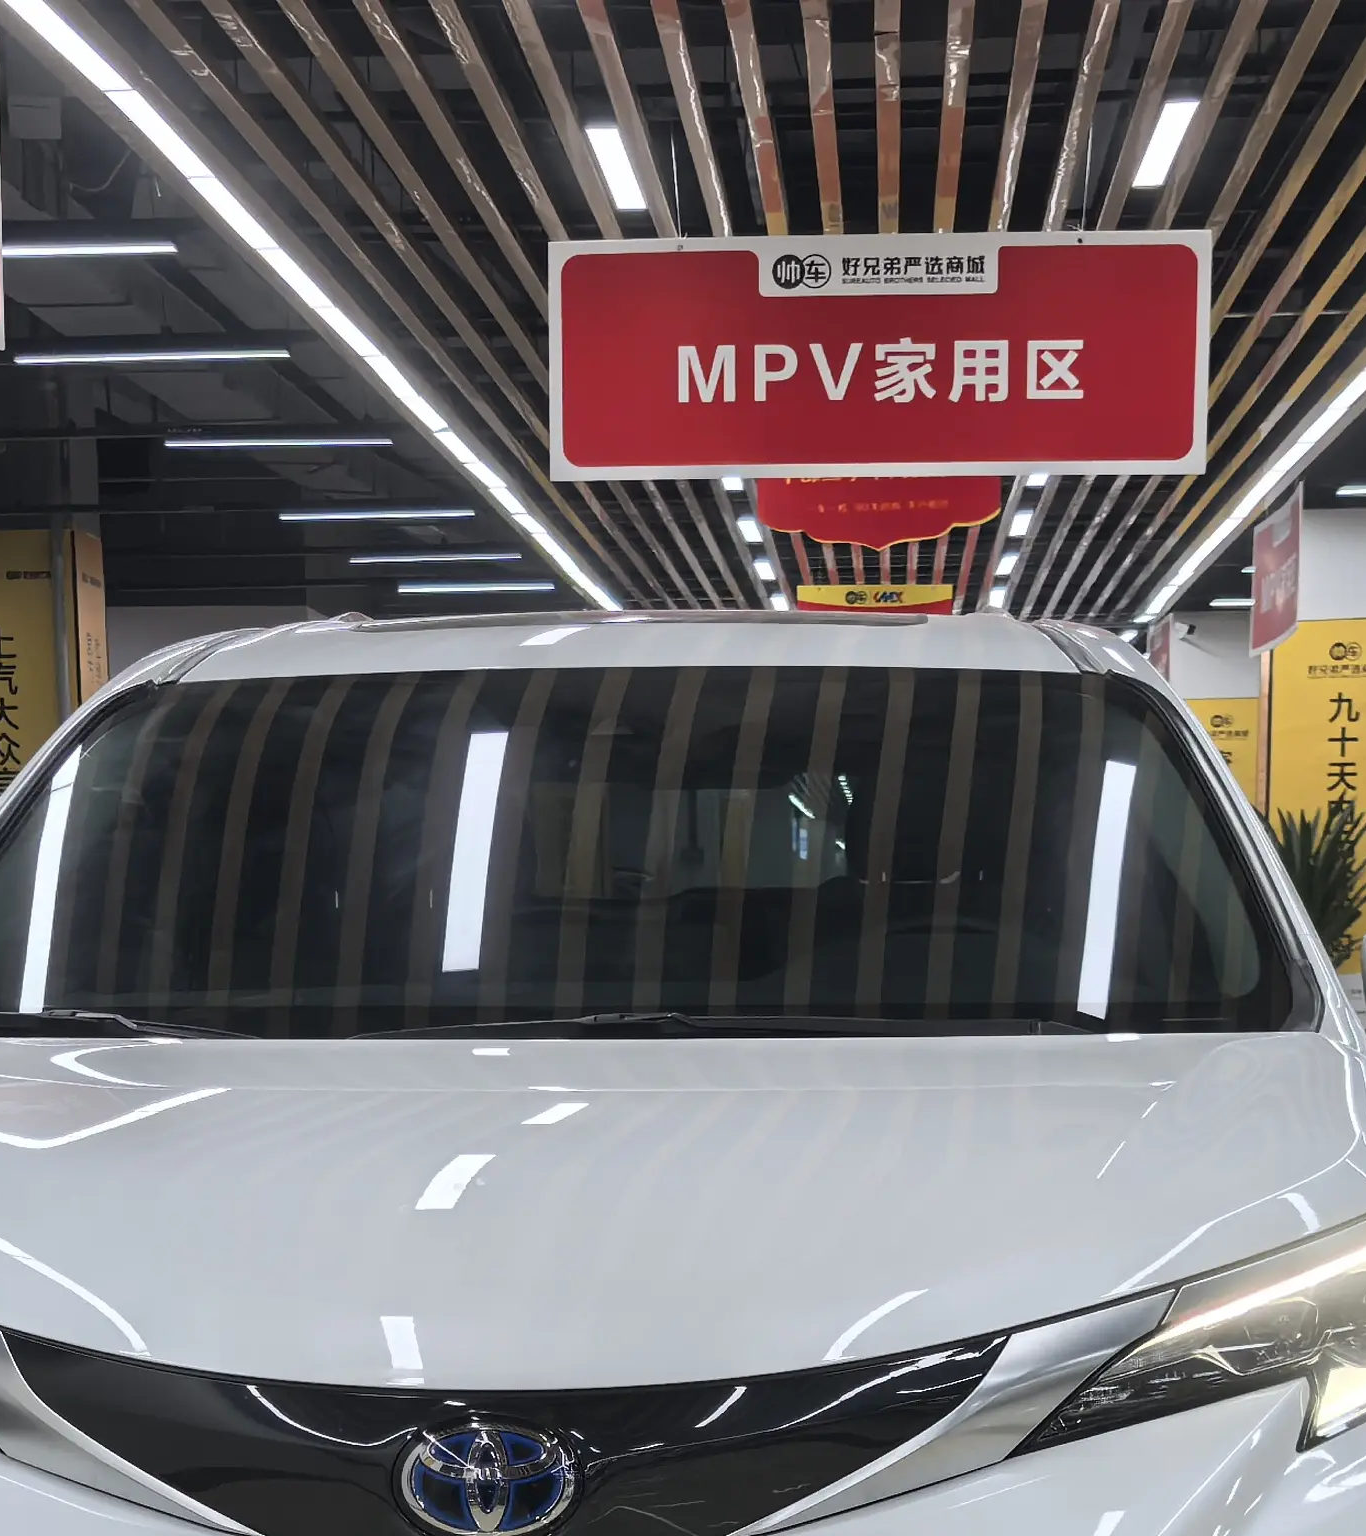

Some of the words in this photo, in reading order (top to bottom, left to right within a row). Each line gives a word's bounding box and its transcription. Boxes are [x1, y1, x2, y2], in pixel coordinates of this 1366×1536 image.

[842, 256, 985, 276] 好兄弟严选商城
[884, 276, 924, 284] BROTHERS
[677, 337, 1085, 404] MPV家用区
